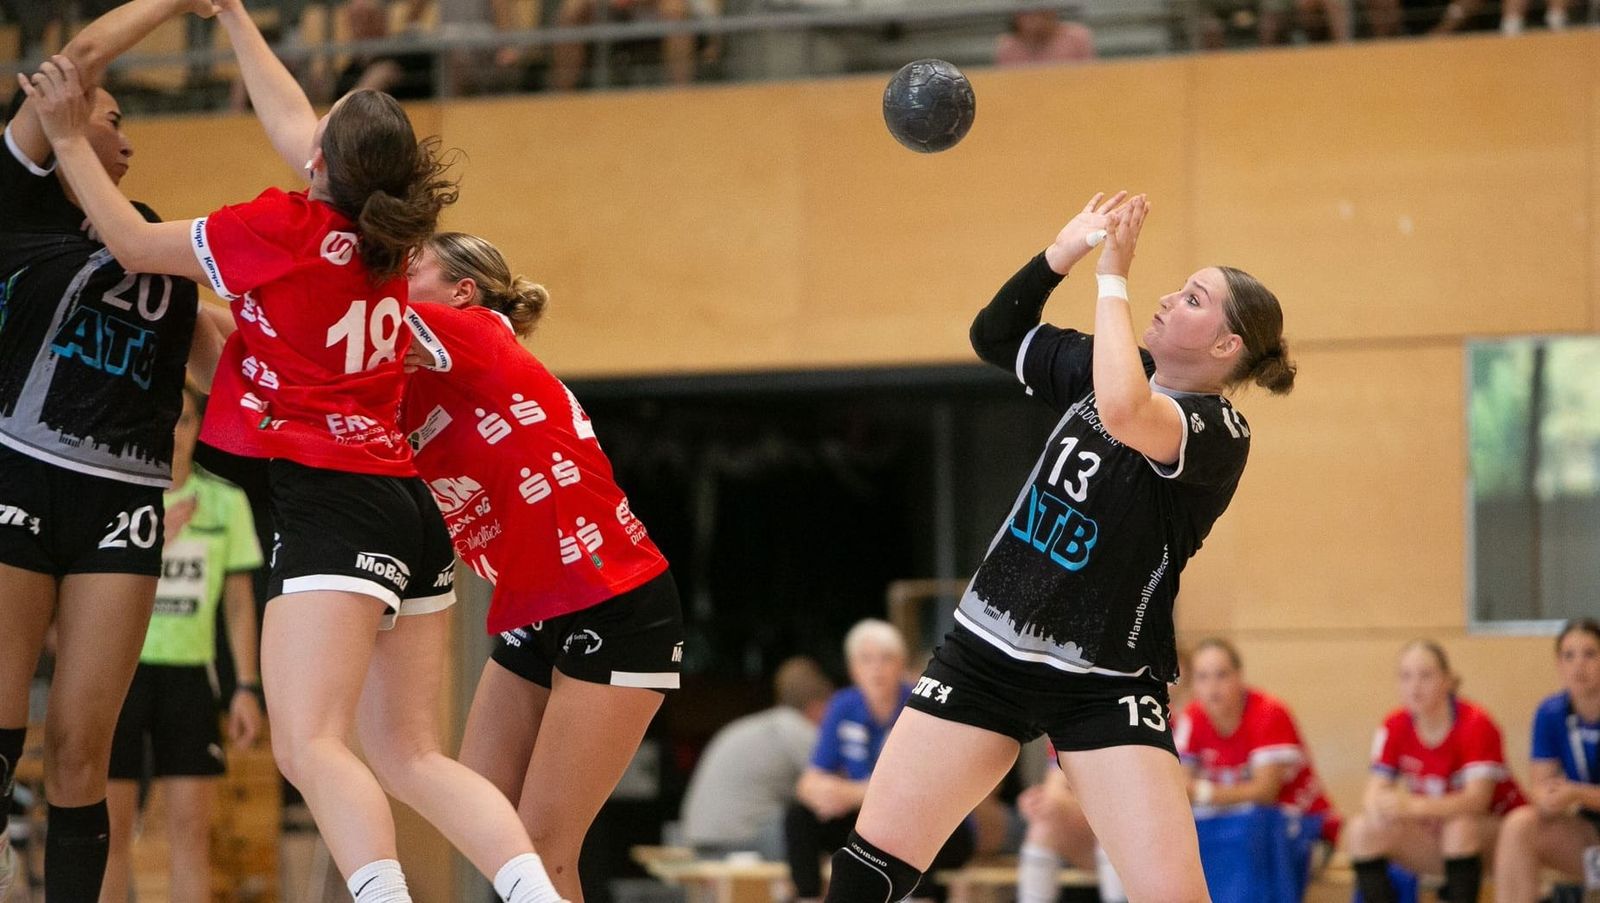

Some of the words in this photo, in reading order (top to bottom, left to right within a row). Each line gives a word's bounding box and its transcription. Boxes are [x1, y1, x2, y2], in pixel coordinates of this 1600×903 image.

[101, 271, 173, 322] 20
[325, 296, 402, 374] 18
[408, 314, 432, 343] Kempa
[1047, 436, 1101, 502] 13
[98, 505, 158, 549] 20
[355, 553, 408, 591] MoBau
[1118, 695, 1166, 732] 13
